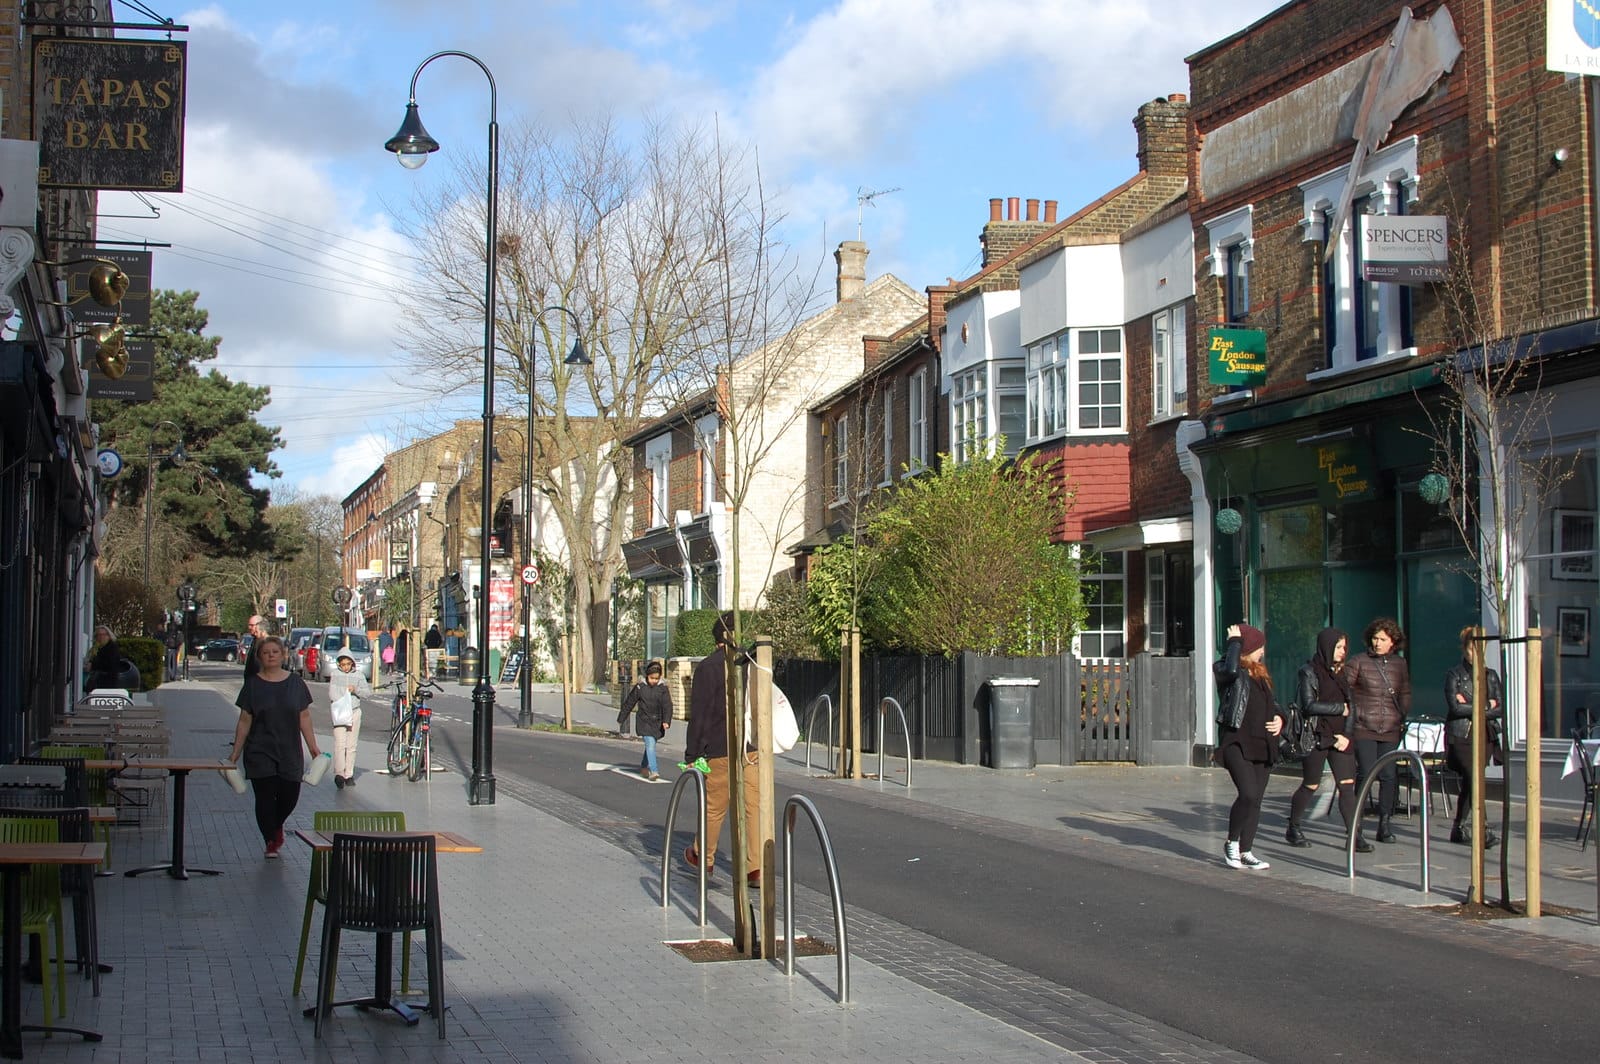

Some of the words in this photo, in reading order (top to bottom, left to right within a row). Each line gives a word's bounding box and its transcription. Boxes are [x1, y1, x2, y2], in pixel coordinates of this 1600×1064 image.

[1564, 54, 1581, 66] LA
[48, 77, 172, 109] TAPAS
[63, 119, 152, 150] BAR
[1366, 228, 1444, 244] SPENCERS
[1409, 268, 1422, 276] TO
[1209, 336, 1234, 350] East
[1218, 348, 1256, 361] London
[1226, 358, 1265, 372] Sausage
[1327, 463, 1358, 483] London
[1337, 478, 1368, 498] Sausage
[524, 570, 537, 579] 20
